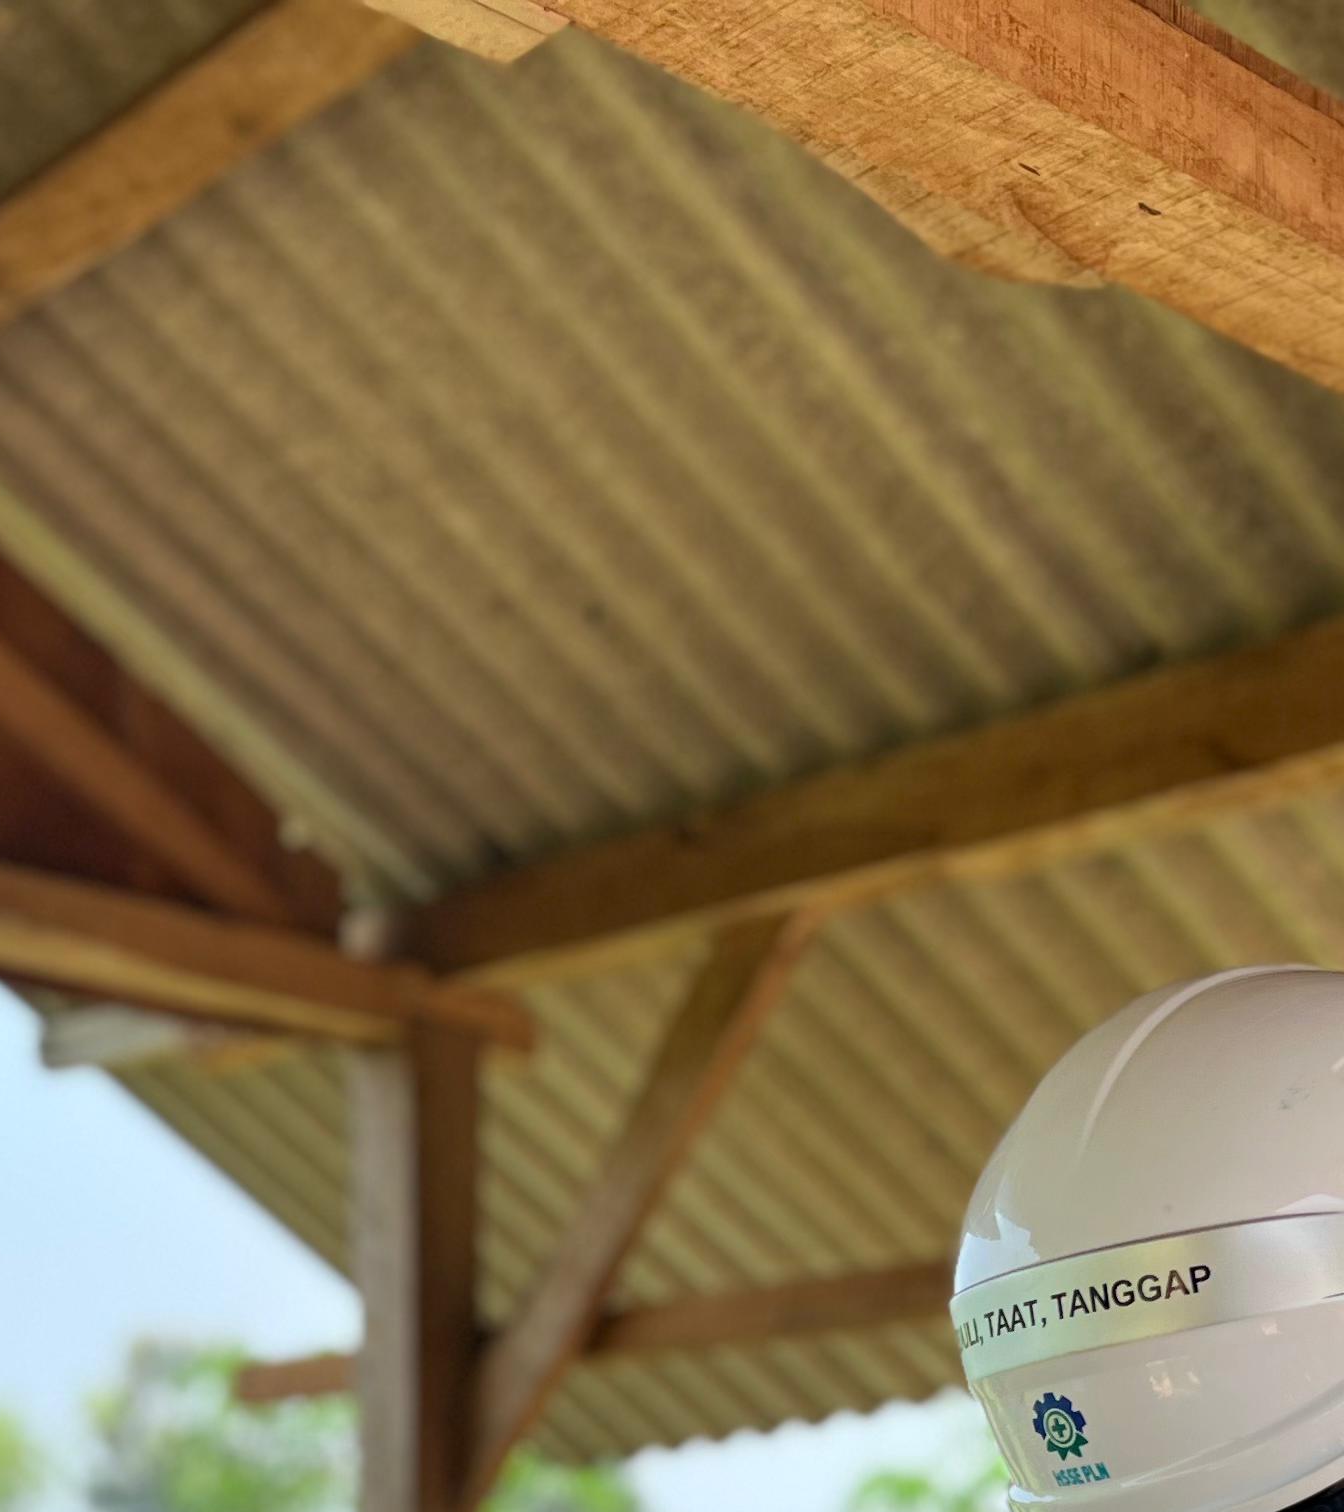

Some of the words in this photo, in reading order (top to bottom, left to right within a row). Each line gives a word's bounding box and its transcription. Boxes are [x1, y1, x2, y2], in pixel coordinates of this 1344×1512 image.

[959, 1317, 985, 1349] ULI,
[983, 1299, 1047, 1338] TAAT,
[1051, 1265, 1212, 1320] TANGGAP
